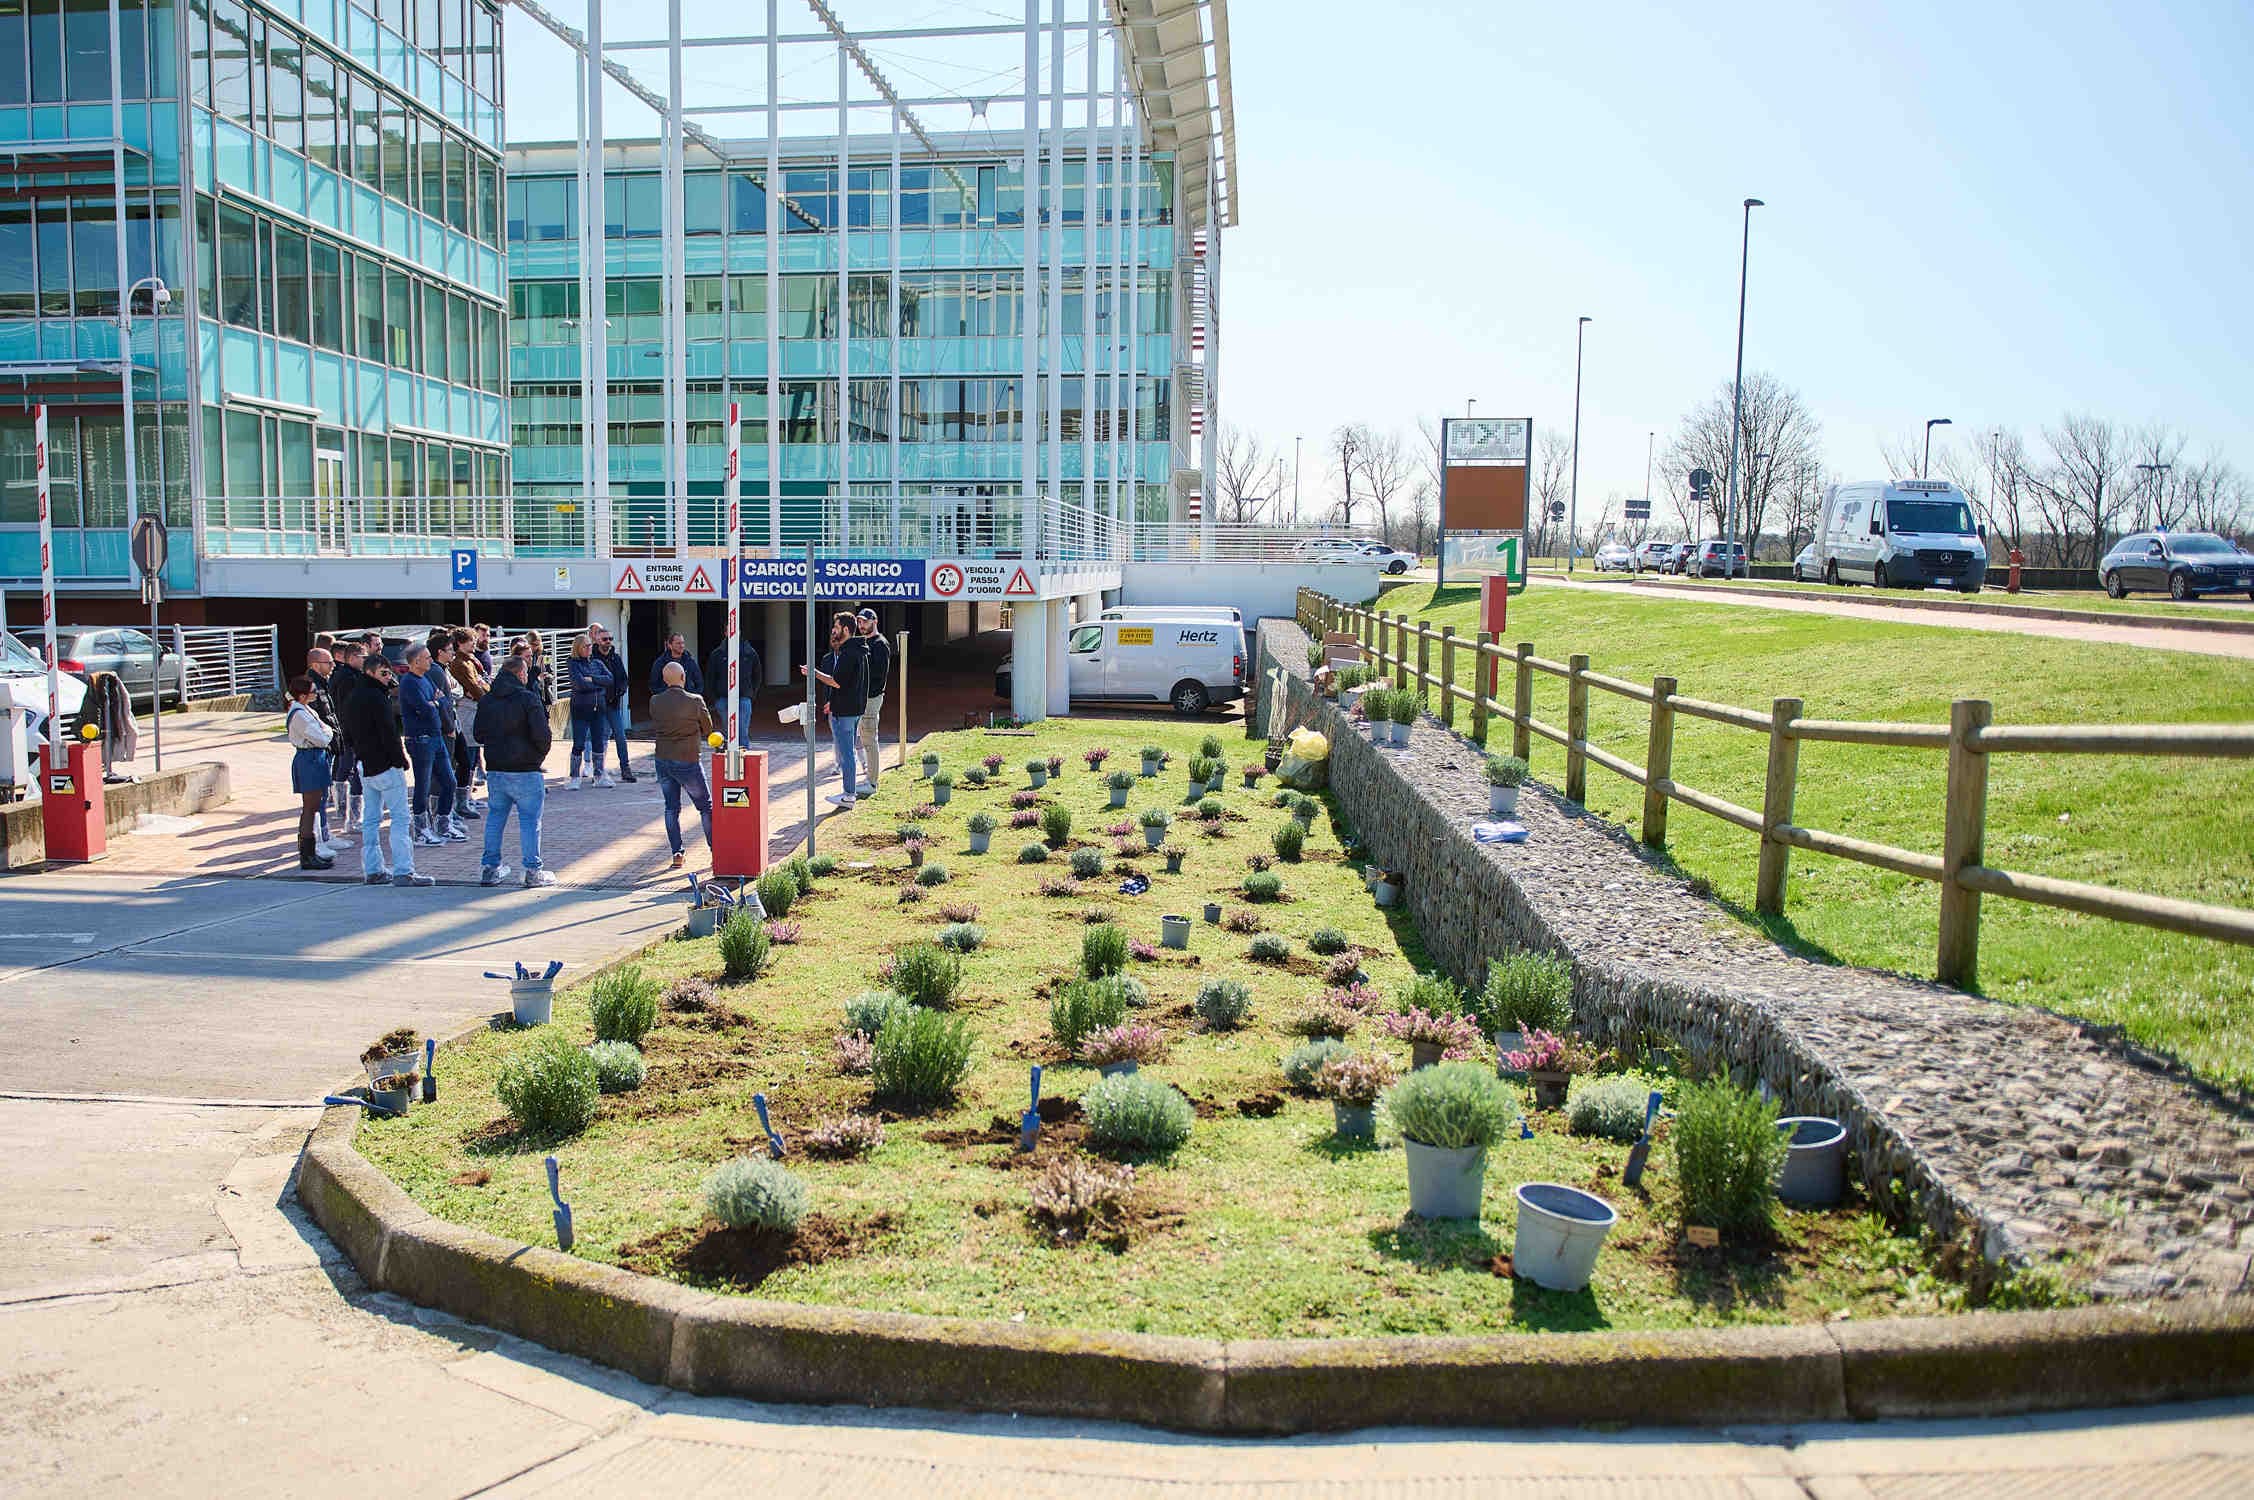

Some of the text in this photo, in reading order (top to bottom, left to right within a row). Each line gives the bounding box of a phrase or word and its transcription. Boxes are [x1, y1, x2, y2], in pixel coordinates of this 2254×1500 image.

[457, 553, 471, 573] P
[1496, 537, 1522, 583] 1
[744, 562, 807, 576] CARICO
[825, 562, 902, 577] SCARICO
[964, 566, 997, 574] VEICOLI
[653, 574, 684, 582] USCIRE
[970, 576, 999, 584] PASSO
[650, 584, 680, 592] ADAGIO
[742, 581, 920, 596] VEICOLI AUTORIZZATI
[967, 586, 1002, 594] D'UOMO
[1180, 630, 1218, 642] Hertz
